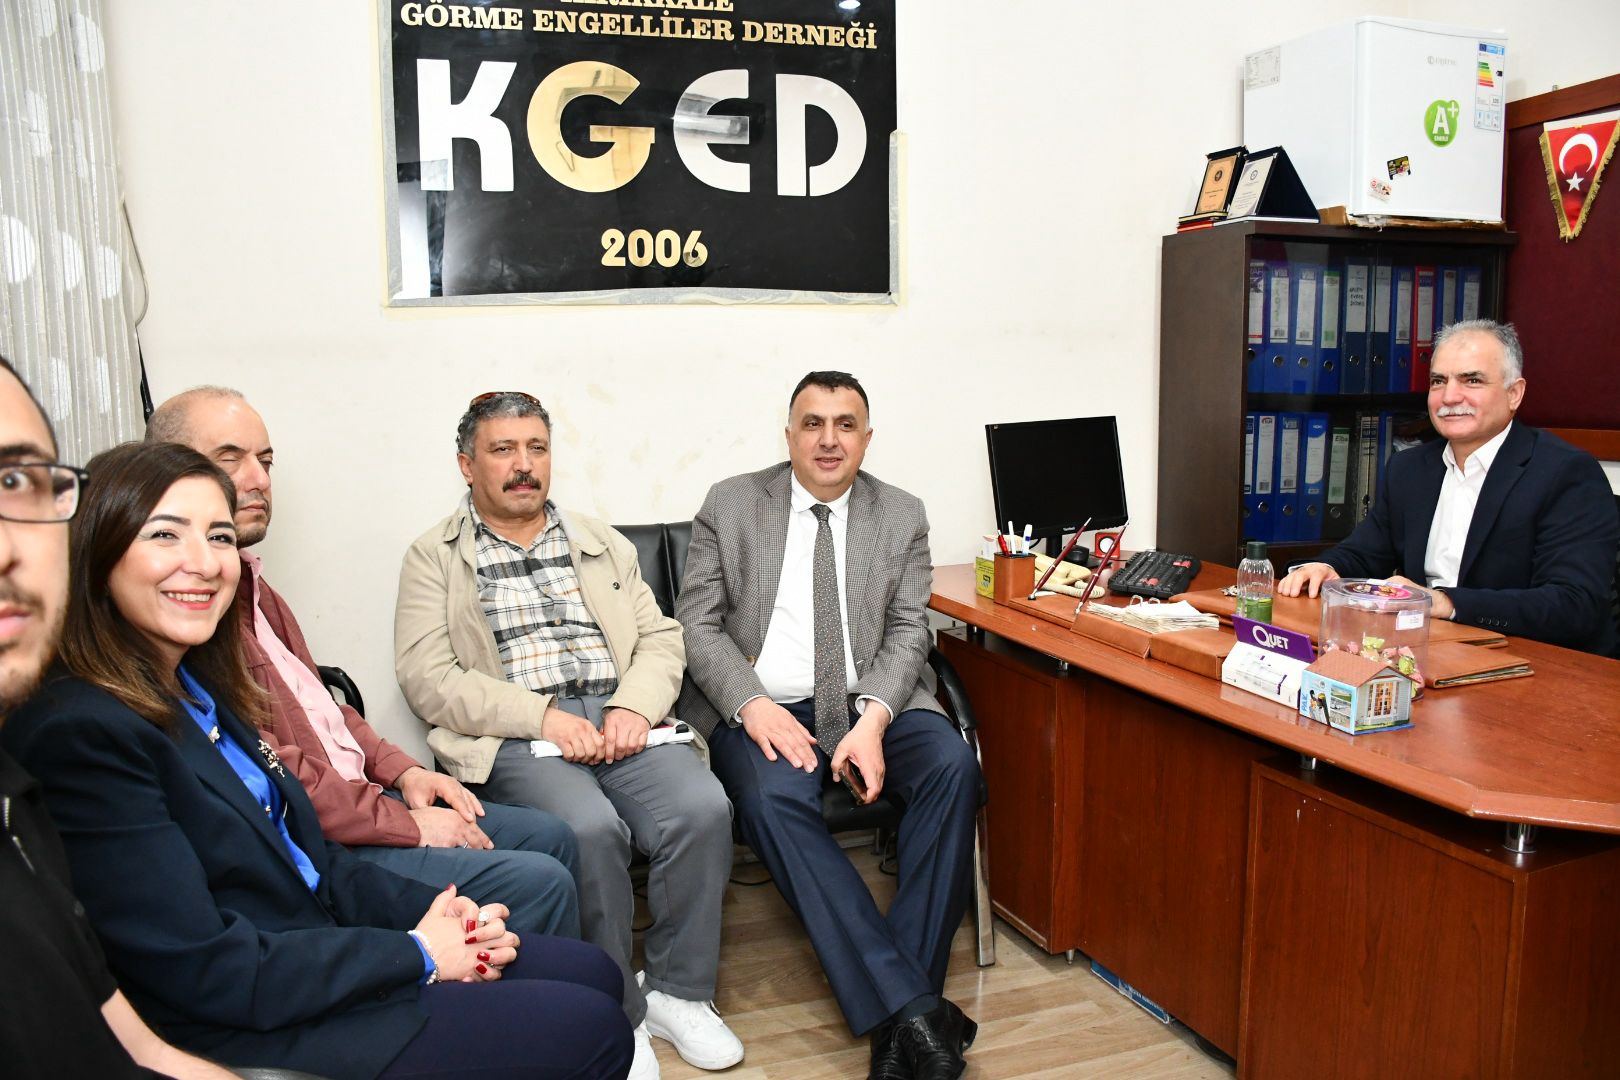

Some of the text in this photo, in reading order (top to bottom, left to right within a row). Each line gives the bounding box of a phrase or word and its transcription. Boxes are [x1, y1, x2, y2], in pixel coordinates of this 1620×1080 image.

[400, 0, 878, 49] GÖRME ENGELLİLER DERNEĞİ
[416, 58, 867, 197] KGED
[600, 228, 709, 268] 2006
[1252, 625, 1289, 650] QUET
